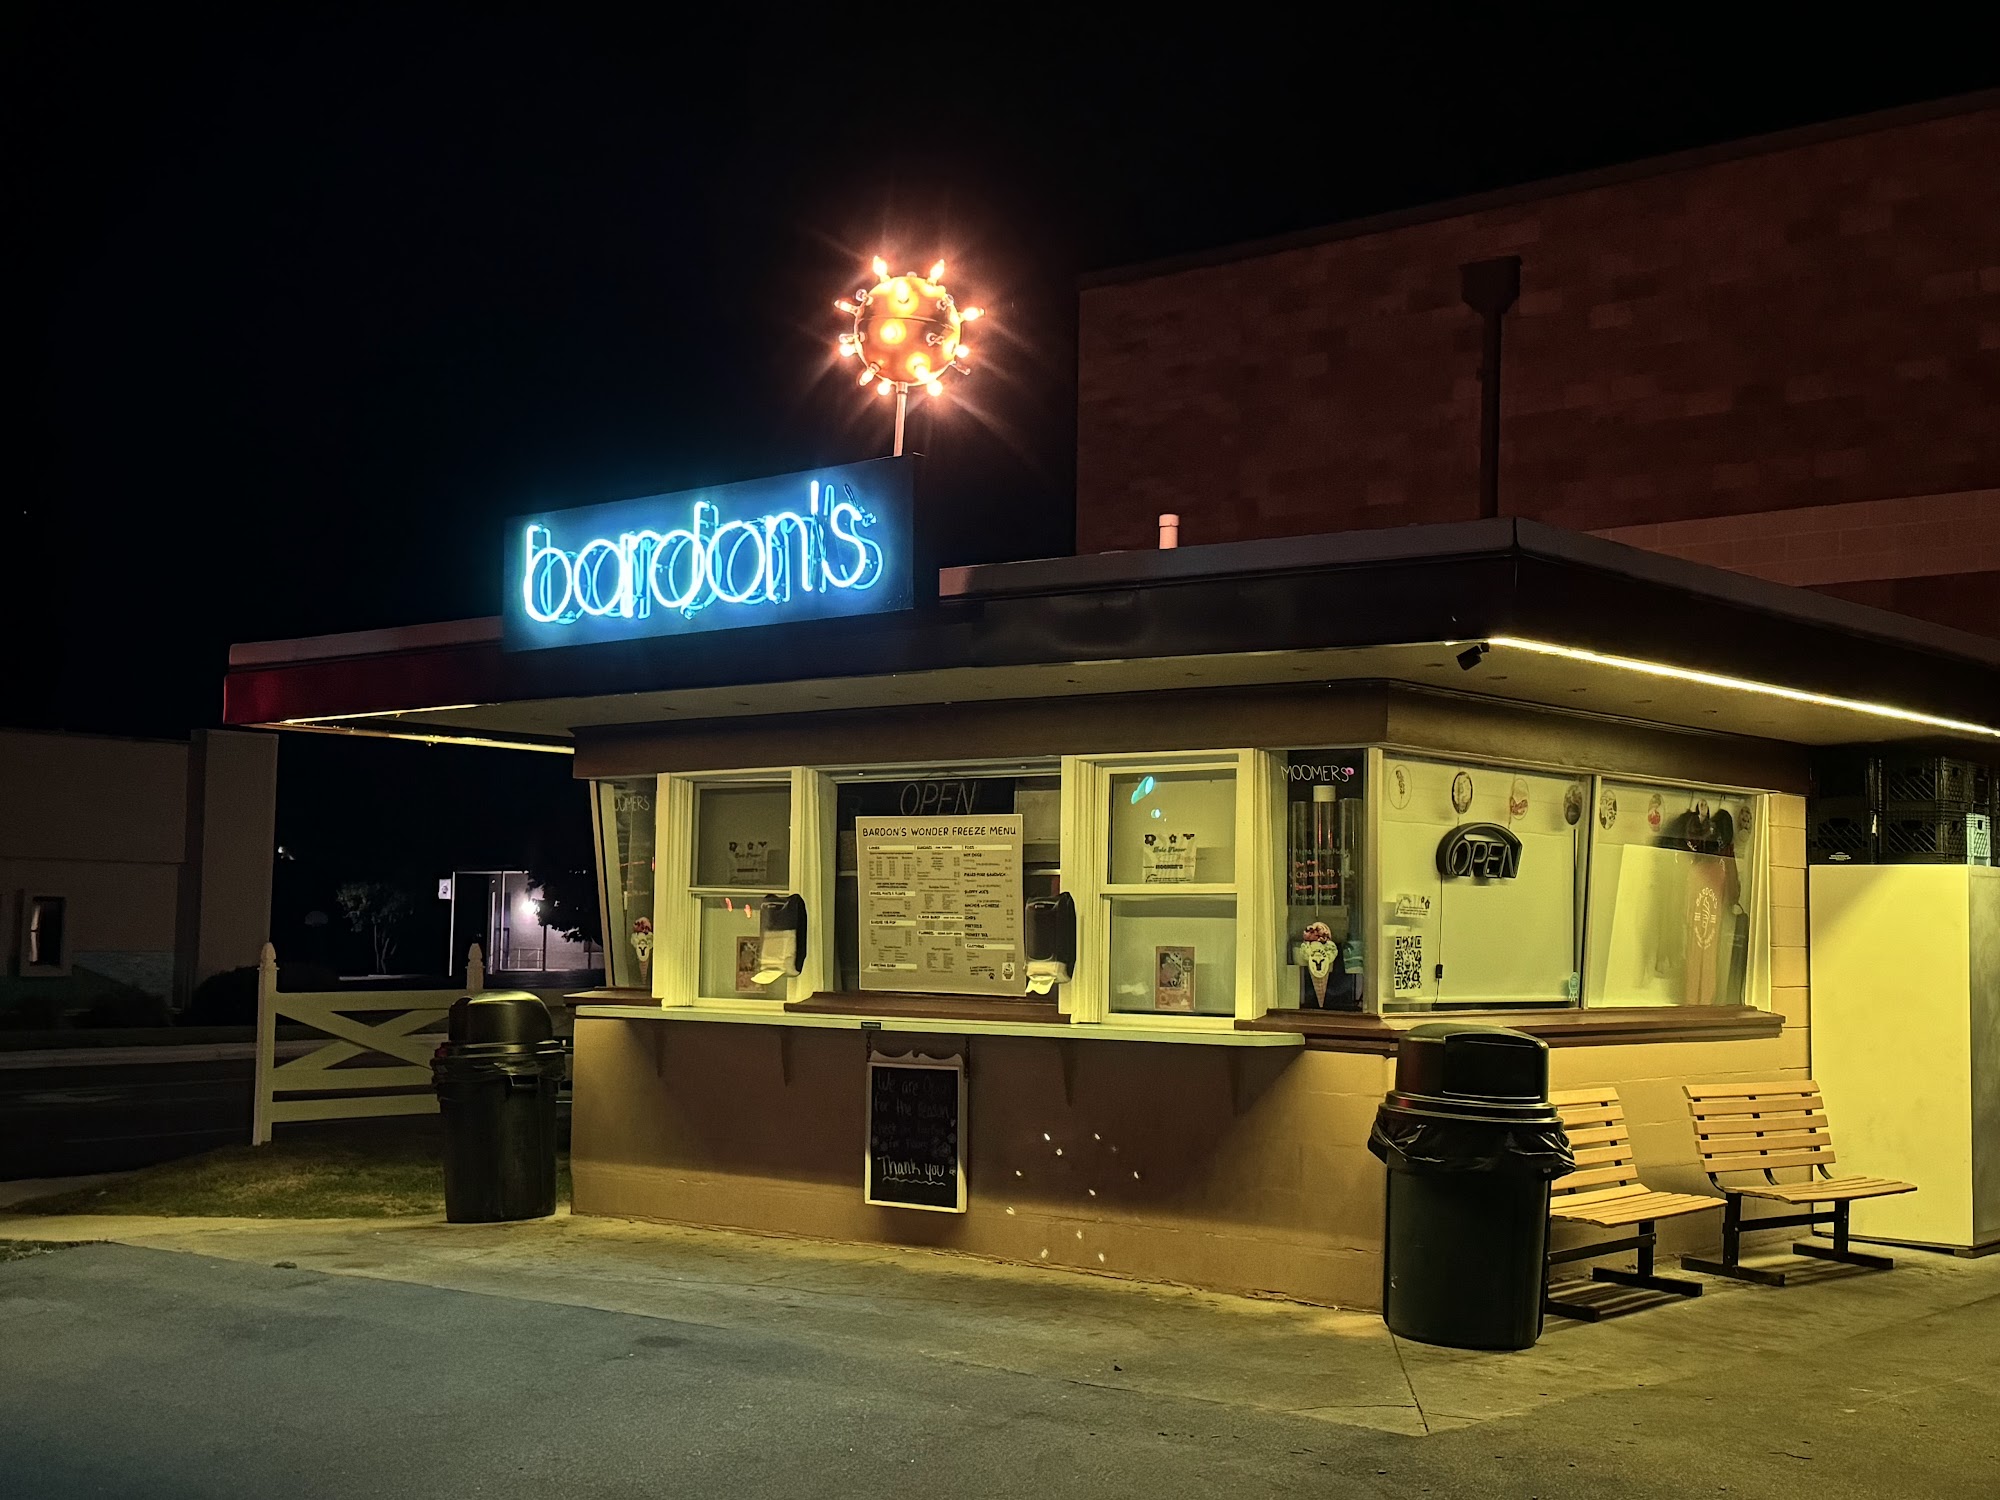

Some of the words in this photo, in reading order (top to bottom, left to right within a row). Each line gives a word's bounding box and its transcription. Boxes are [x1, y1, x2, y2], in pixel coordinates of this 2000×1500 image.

[523, 479, 881, 623] bardon's
[1280, 764, 1350, 783] MOOMERS
[899, 781, 976, 816] OPEN
[862, 827, 907, 837] BARDON'S
[911, 826, 949, 836] WONDER
[952, 826, 986, 836] FREEZE
[989, 826, 1016, 835] MENU
[1450, 839, 1517, 878] OPEN
[876, 1154, 922, 1176] Thank
[924, 1163, 945, 1182] you
